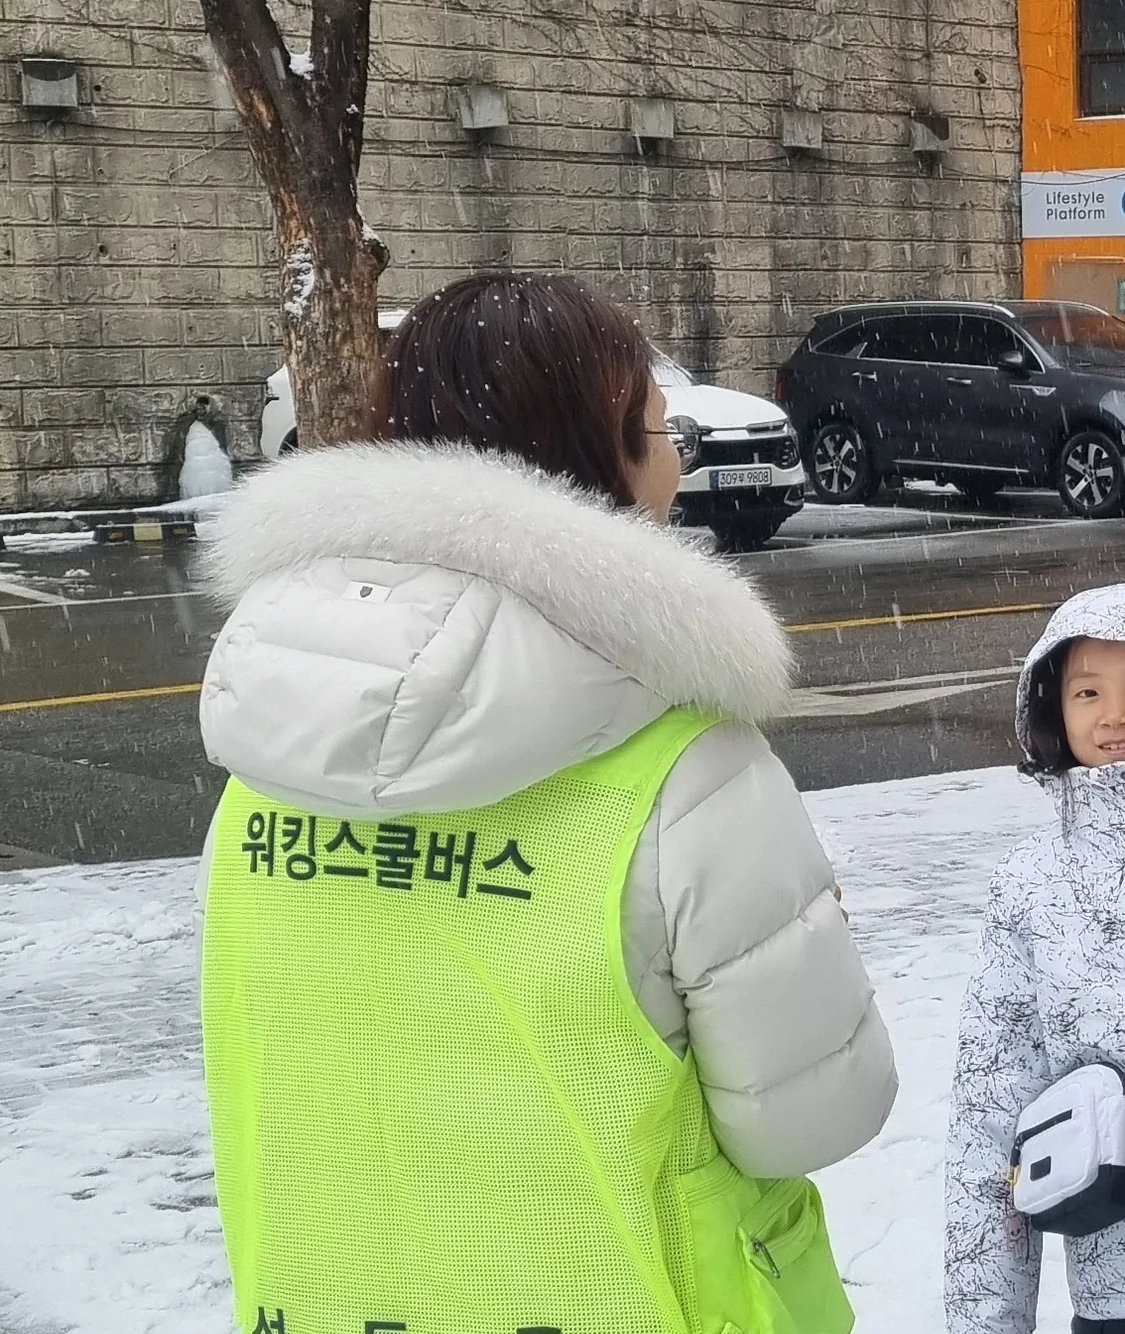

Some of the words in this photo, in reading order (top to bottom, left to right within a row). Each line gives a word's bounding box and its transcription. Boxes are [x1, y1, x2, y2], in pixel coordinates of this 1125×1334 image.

[1046, 191, 1105, 207] Lifestyle
[1046, 207, 1105, 220] Platform
[746, 470, 769, 483] 9808
[241, 810, 537, 901] 워킹스쿨버스
